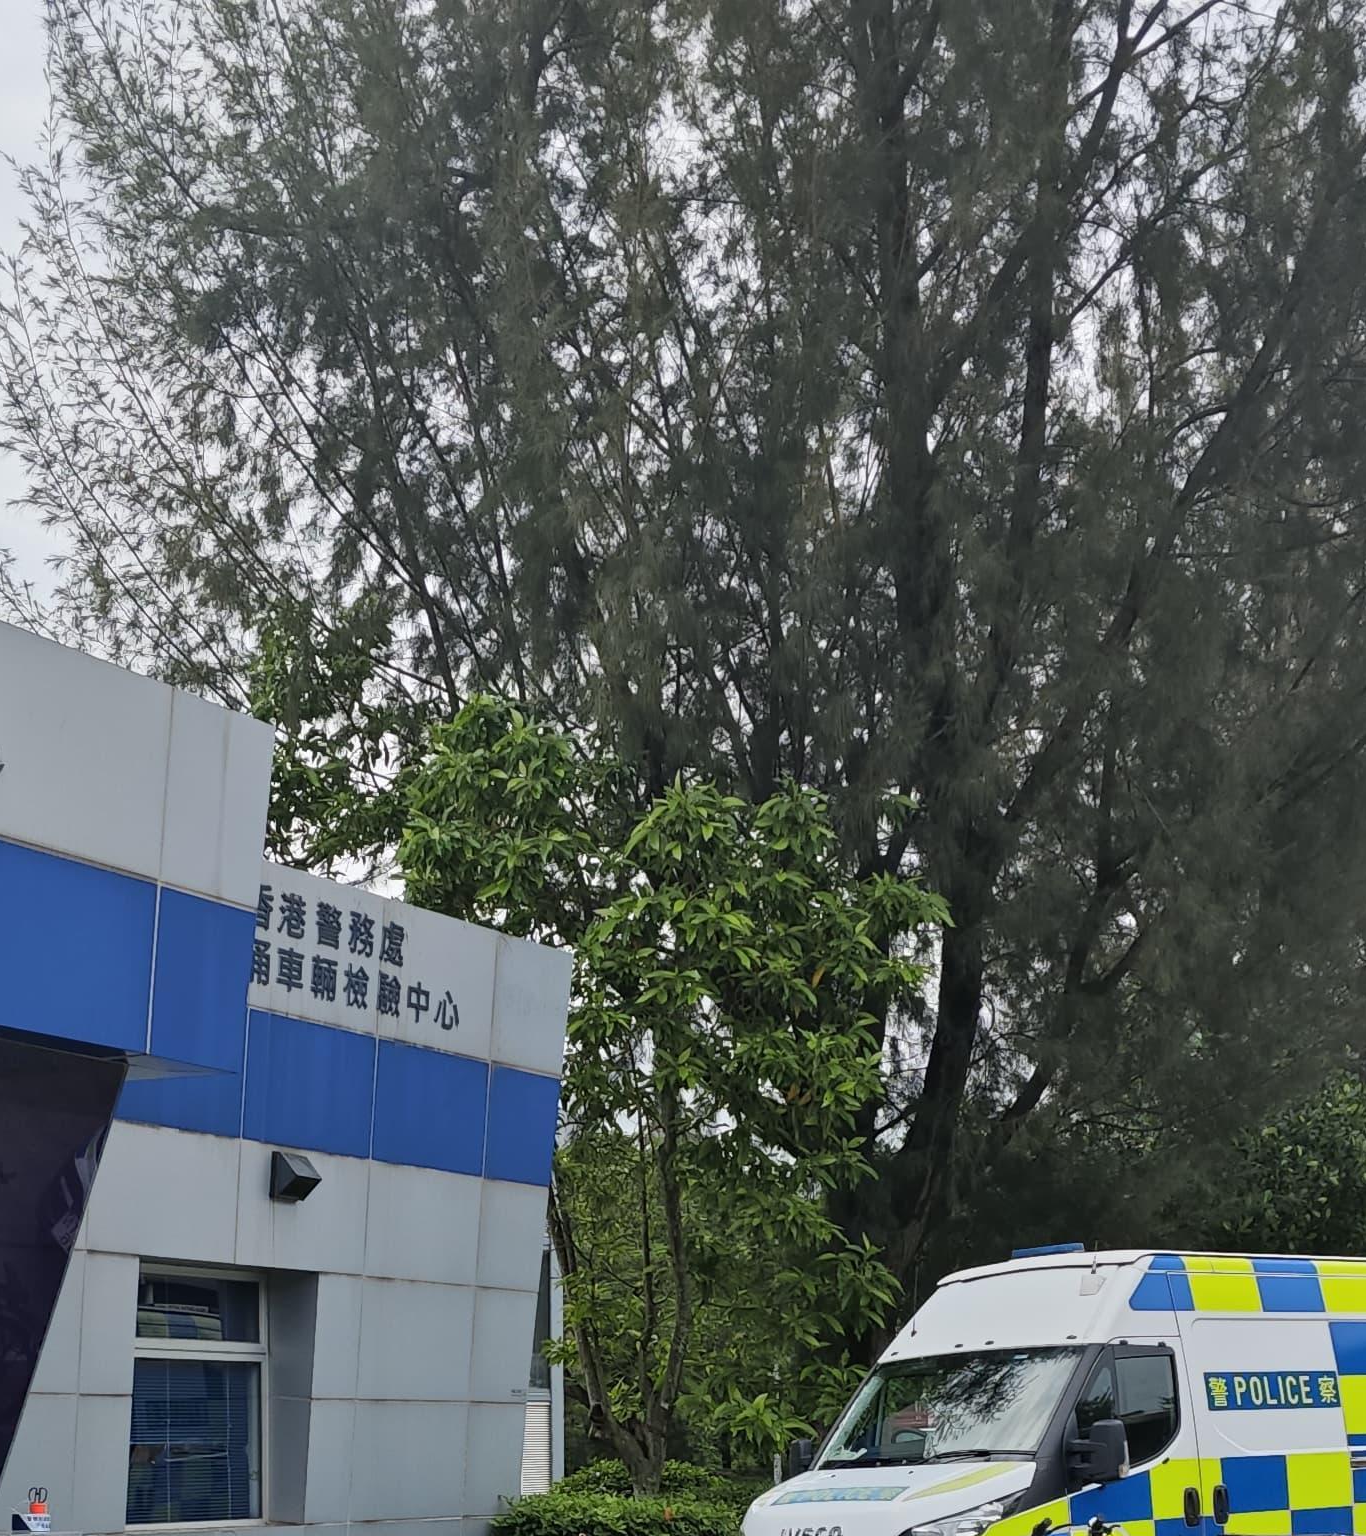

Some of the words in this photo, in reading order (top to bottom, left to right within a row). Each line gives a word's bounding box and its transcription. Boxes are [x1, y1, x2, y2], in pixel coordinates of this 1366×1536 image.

[1208, 1377, 1228, 1407] 警
[1233, 1375, 1314, 1405] POLICE
[1317, 1375, 1337, 1404] 察
